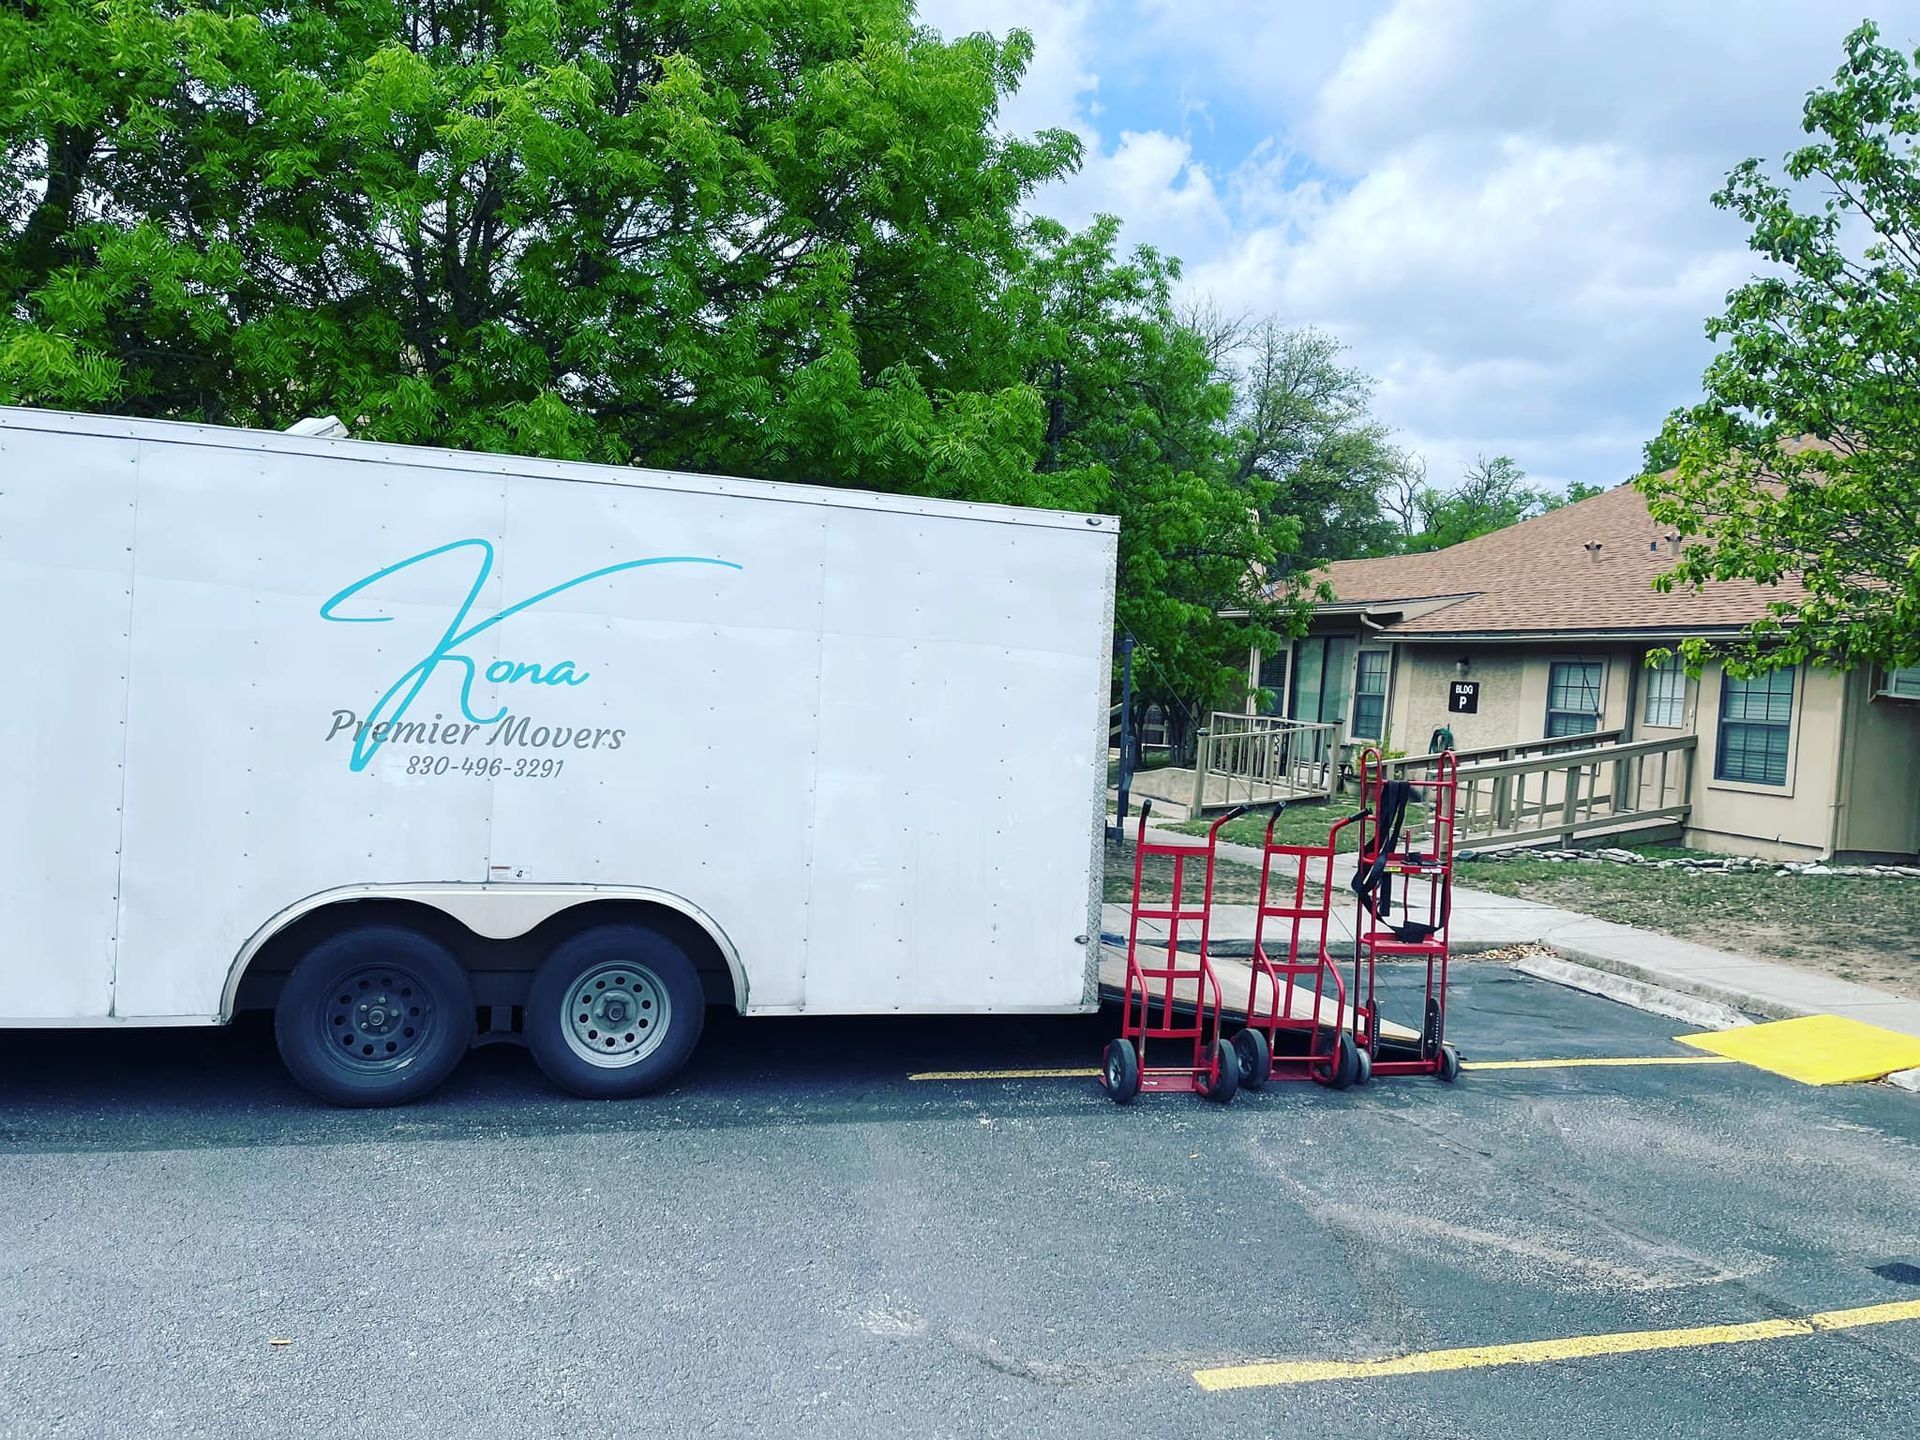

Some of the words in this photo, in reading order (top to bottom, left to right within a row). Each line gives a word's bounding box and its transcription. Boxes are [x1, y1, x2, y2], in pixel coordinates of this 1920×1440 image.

[320, 538, 743, 772] Kona
[1455, 684, 1473, 695] BLDG
[1459, 696, 1467, 709] P
[325, 709, 480, 748] Premier
[486, 715, 627, 750] Movers
[406, 756, 565, 780] 830-496-3291
